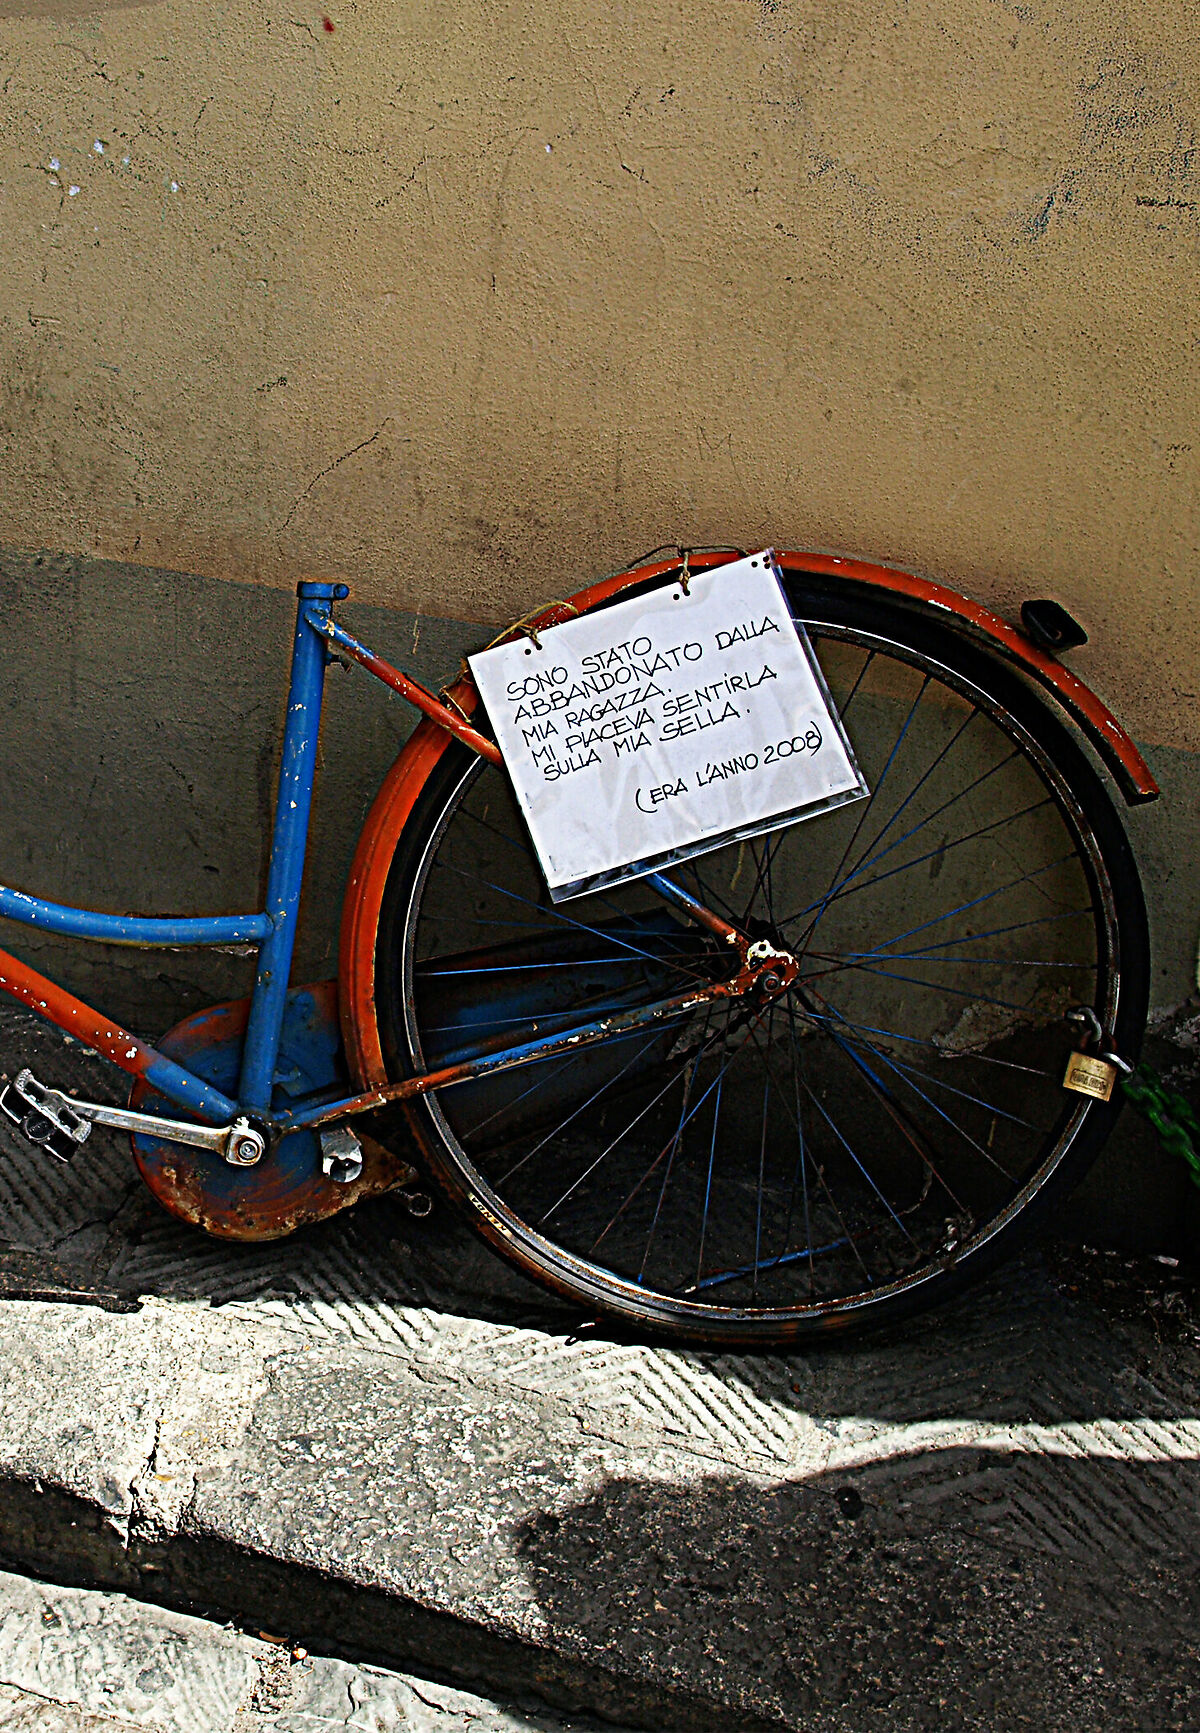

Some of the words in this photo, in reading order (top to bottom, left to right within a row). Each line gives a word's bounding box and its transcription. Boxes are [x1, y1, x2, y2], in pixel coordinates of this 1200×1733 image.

[507, 666, 568, 701] SONO
[581, 637, 652, 675] STATO
[514, 643, 702, 724] ABBANDONATO
[715, 616, 780, 651] DALLA
[522, 720, 559, 747] MIA
[532, 744, 556, 767] MI
[565, 708, 655, 753] PIACEVA
[663, 665, 777, 717] SENTIRLA
[544, 749, 602, 781] SULLA
[613, 732, 652, 757] MIA
[635, 778, 688, 813] (ERA
[696, 753, 759, 787] L'ANNO
[763, 720, 823, 757] 2008)
[471, 1197, 507, 1231] KENDA
